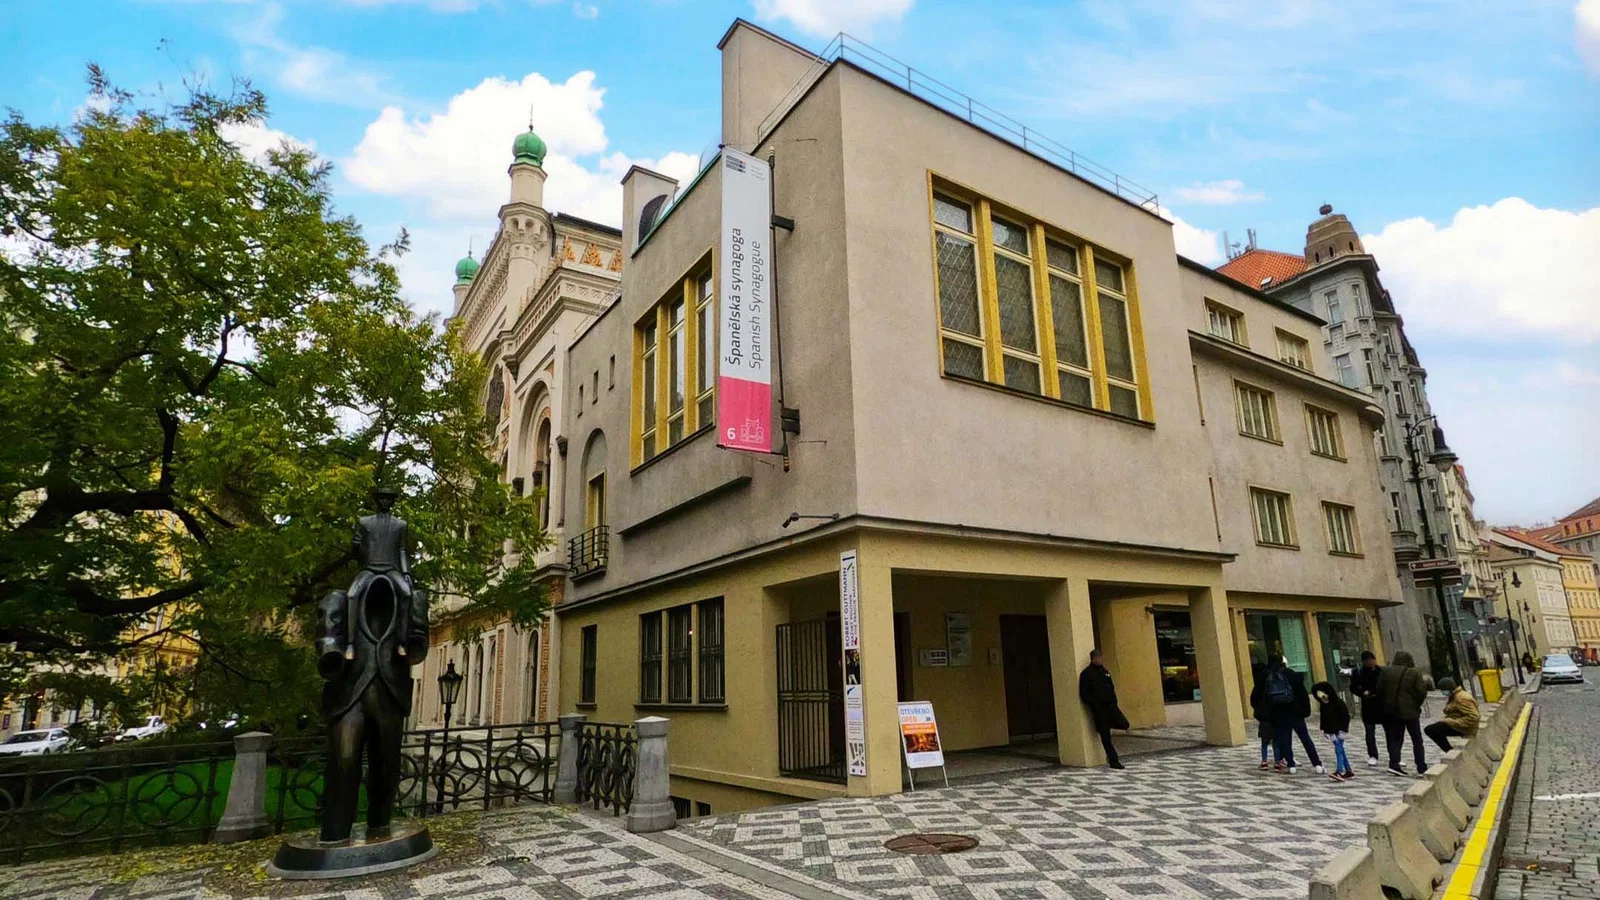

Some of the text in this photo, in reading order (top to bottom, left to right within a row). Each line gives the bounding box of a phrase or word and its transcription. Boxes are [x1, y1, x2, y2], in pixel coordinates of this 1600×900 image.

[725, 228, 744, 365] Španělská synagoga
[749, 241, 764, 369] Spanish Synagogue
[727, 427, 736, 440] 6
